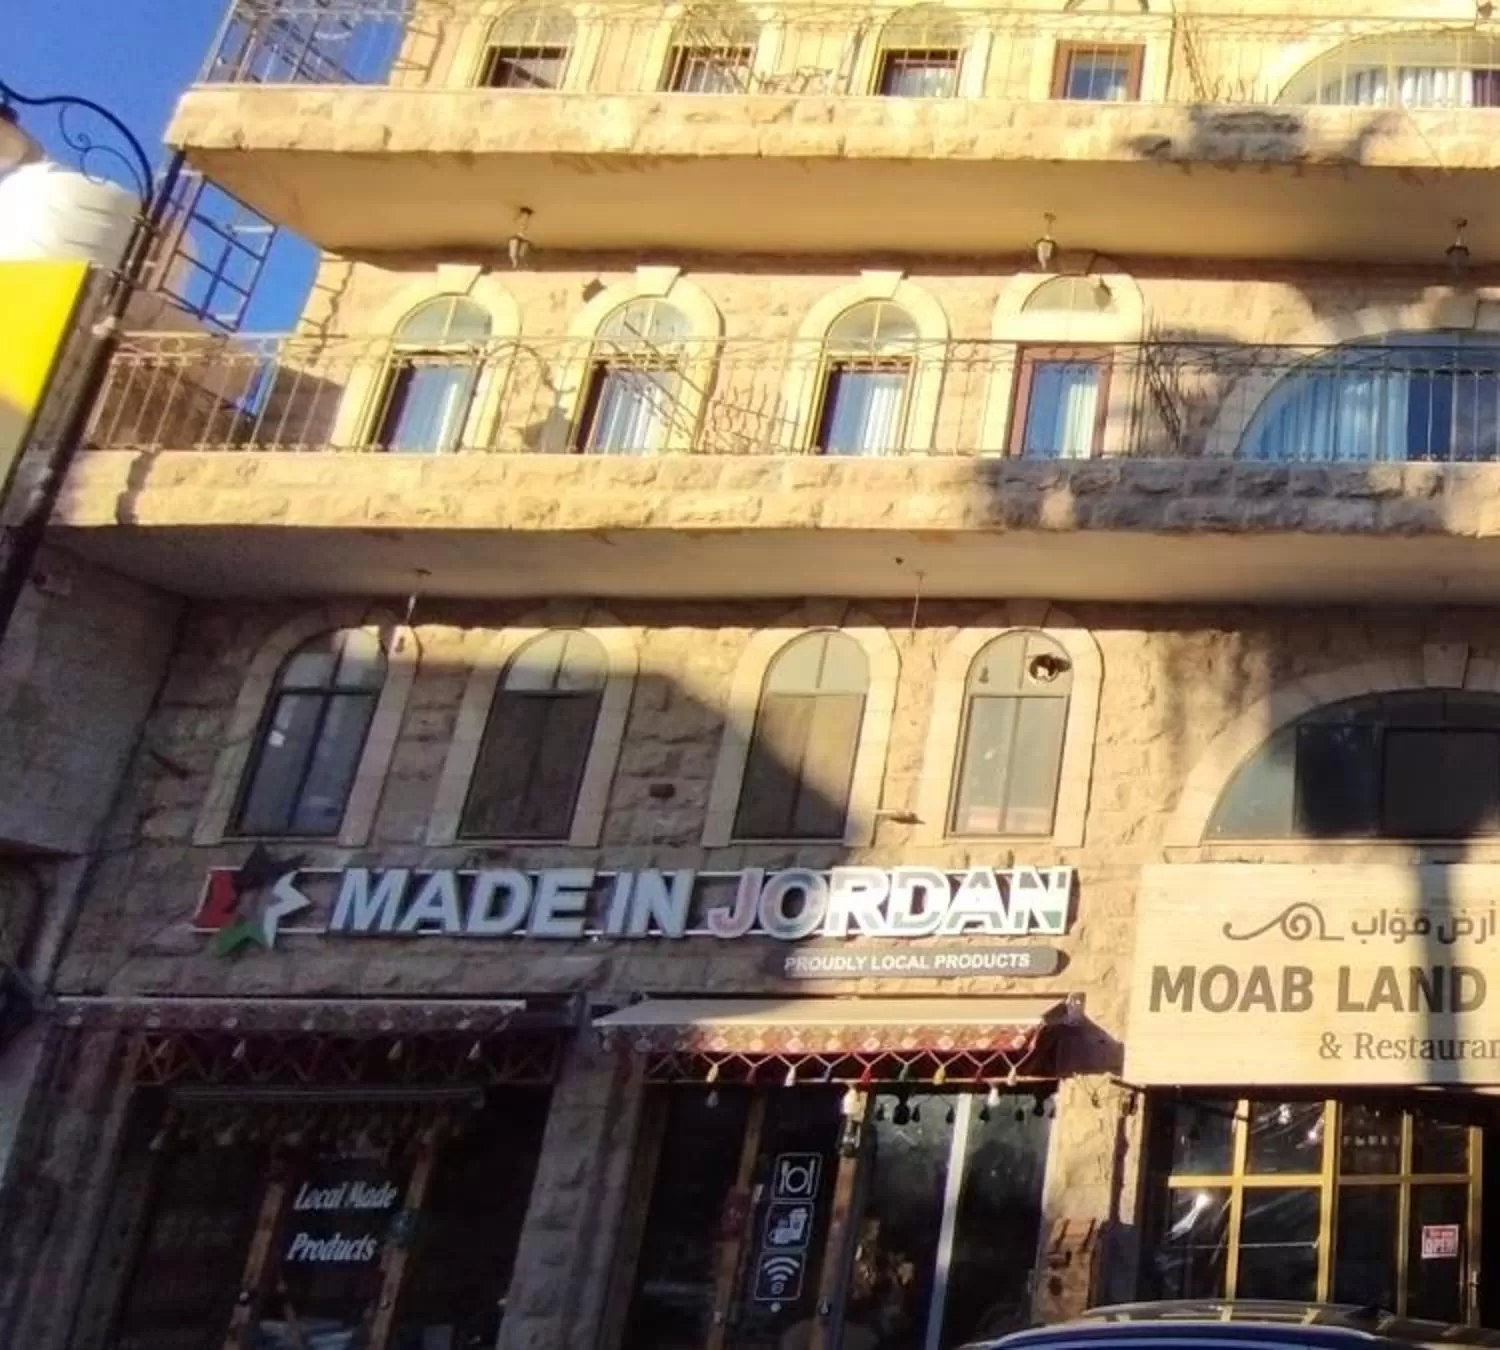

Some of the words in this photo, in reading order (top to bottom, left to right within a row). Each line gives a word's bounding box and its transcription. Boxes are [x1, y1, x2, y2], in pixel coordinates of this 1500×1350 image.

[331, 867, 596, 938] MADE
[606, 867, 697, 938] IN
[706, 866, 1073, 940] JORDAN
[1437, 899, 1497, 945] أرض
[783, 955, 868, 972] PROUDLY
[870, 955, 930, 971] LOCAL
[933, 952, 1032, 970] PRODUCTS
[1148, 964, 1314, 1014] MOAB
[1336, 964, 1488, 1014] LAND
[1318, 1031, 1343, 1061] &
[293, 1180, 349, 1211] Local
[343, 1180, 399, 1210] Made
[286, 1231, 379, 1261] Products
